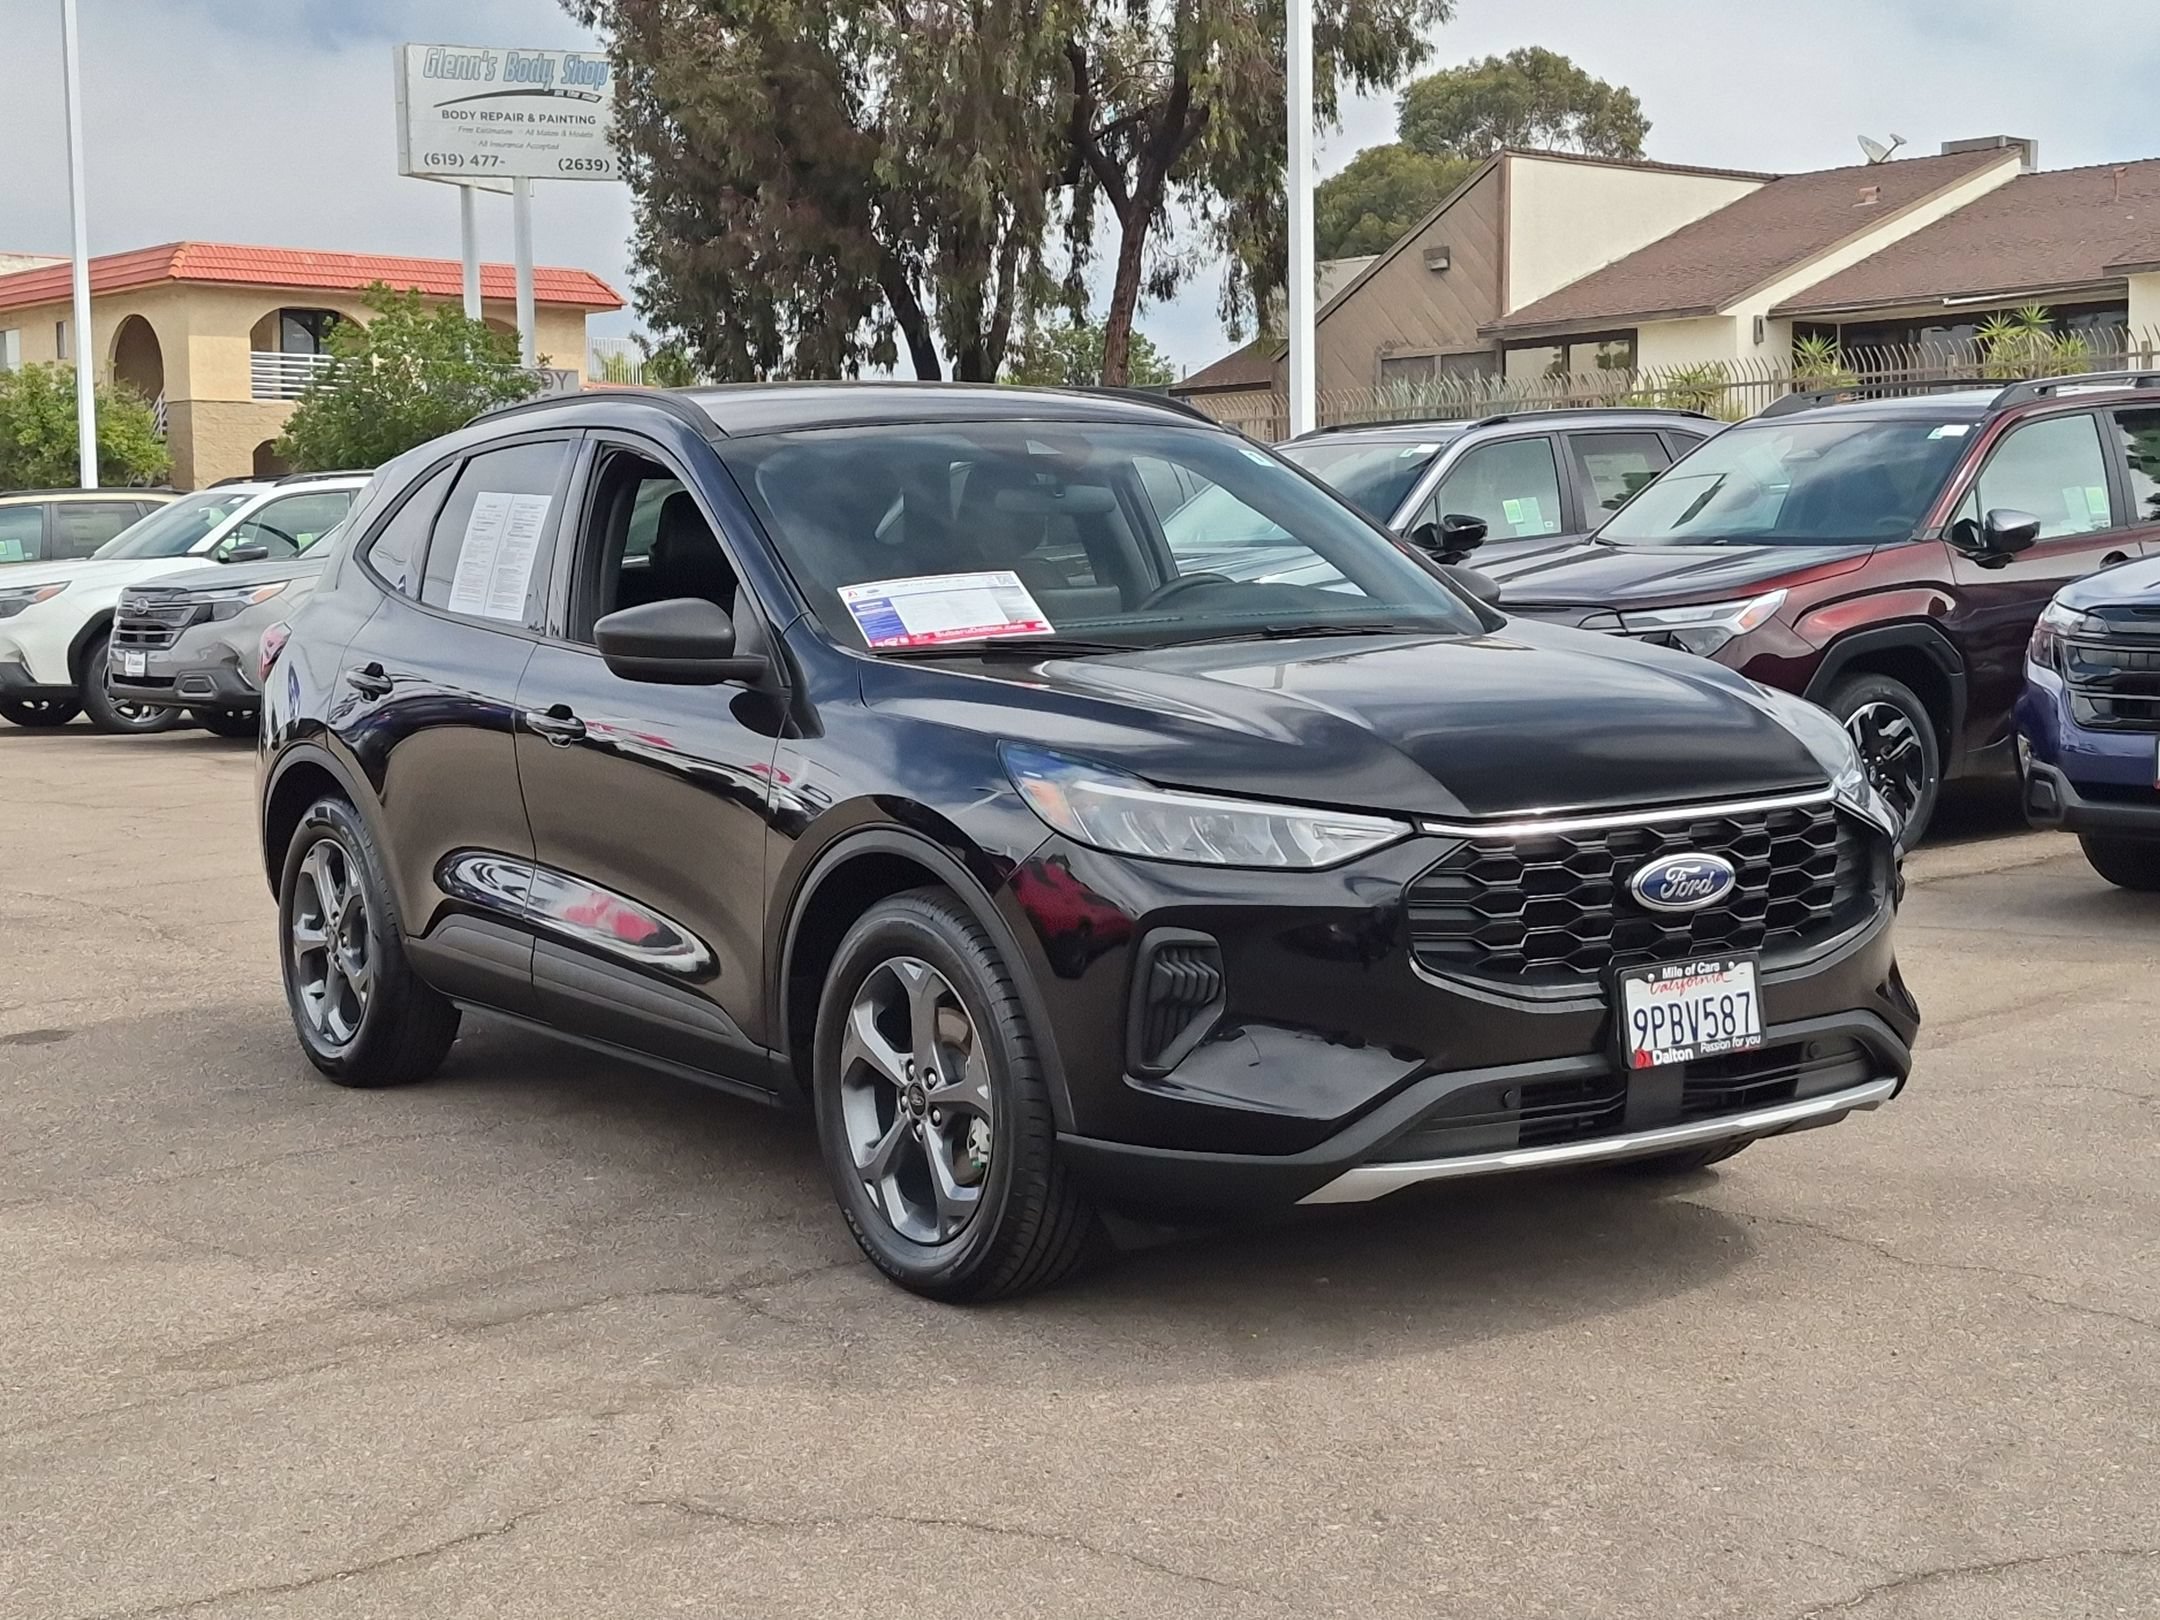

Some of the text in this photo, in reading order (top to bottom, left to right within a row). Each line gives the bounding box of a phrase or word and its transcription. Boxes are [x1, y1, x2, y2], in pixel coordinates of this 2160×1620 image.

[423, 47, 609, 92] Glenn's Body Shop
[441, 109, 596, 125] BODY REPAIR & PAINTING
[424, 153, 465, 167] (619)
[558, 158, 610, 173] (2639)
[1660, 865, 1716, 899] Ford
[1662, 962, 1720, 979] Mile of Cars
[1633, 991, 1751, 1050] 9PBV587
[1700, 1034, 1761, 1053] Passion for you
[1652, 1047, 1694, 1066] Dalton
